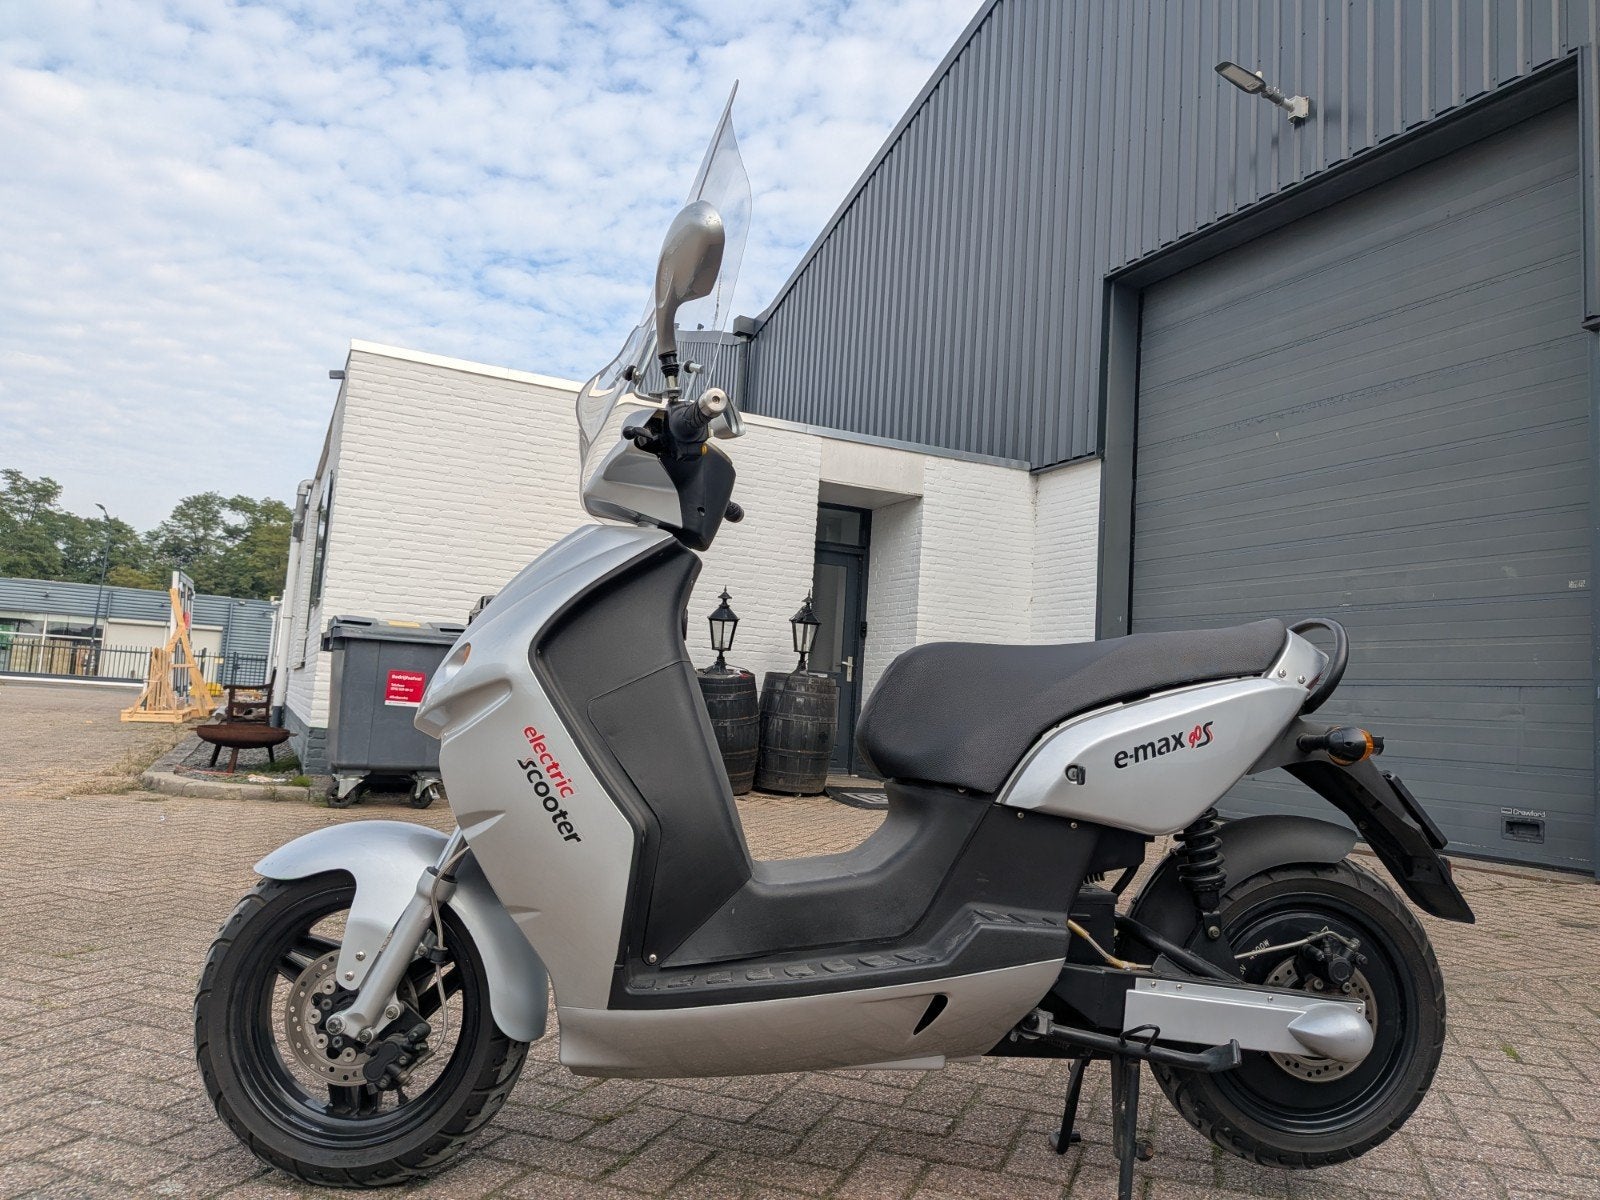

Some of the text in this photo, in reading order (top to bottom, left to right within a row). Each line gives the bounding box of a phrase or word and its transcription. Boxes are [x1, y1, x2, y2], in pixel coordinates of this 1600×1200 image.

[523, 726, 575, 798] electric
[1114, 731, 1186, 769] e-max
[517, 758, 582, 843] scooter
